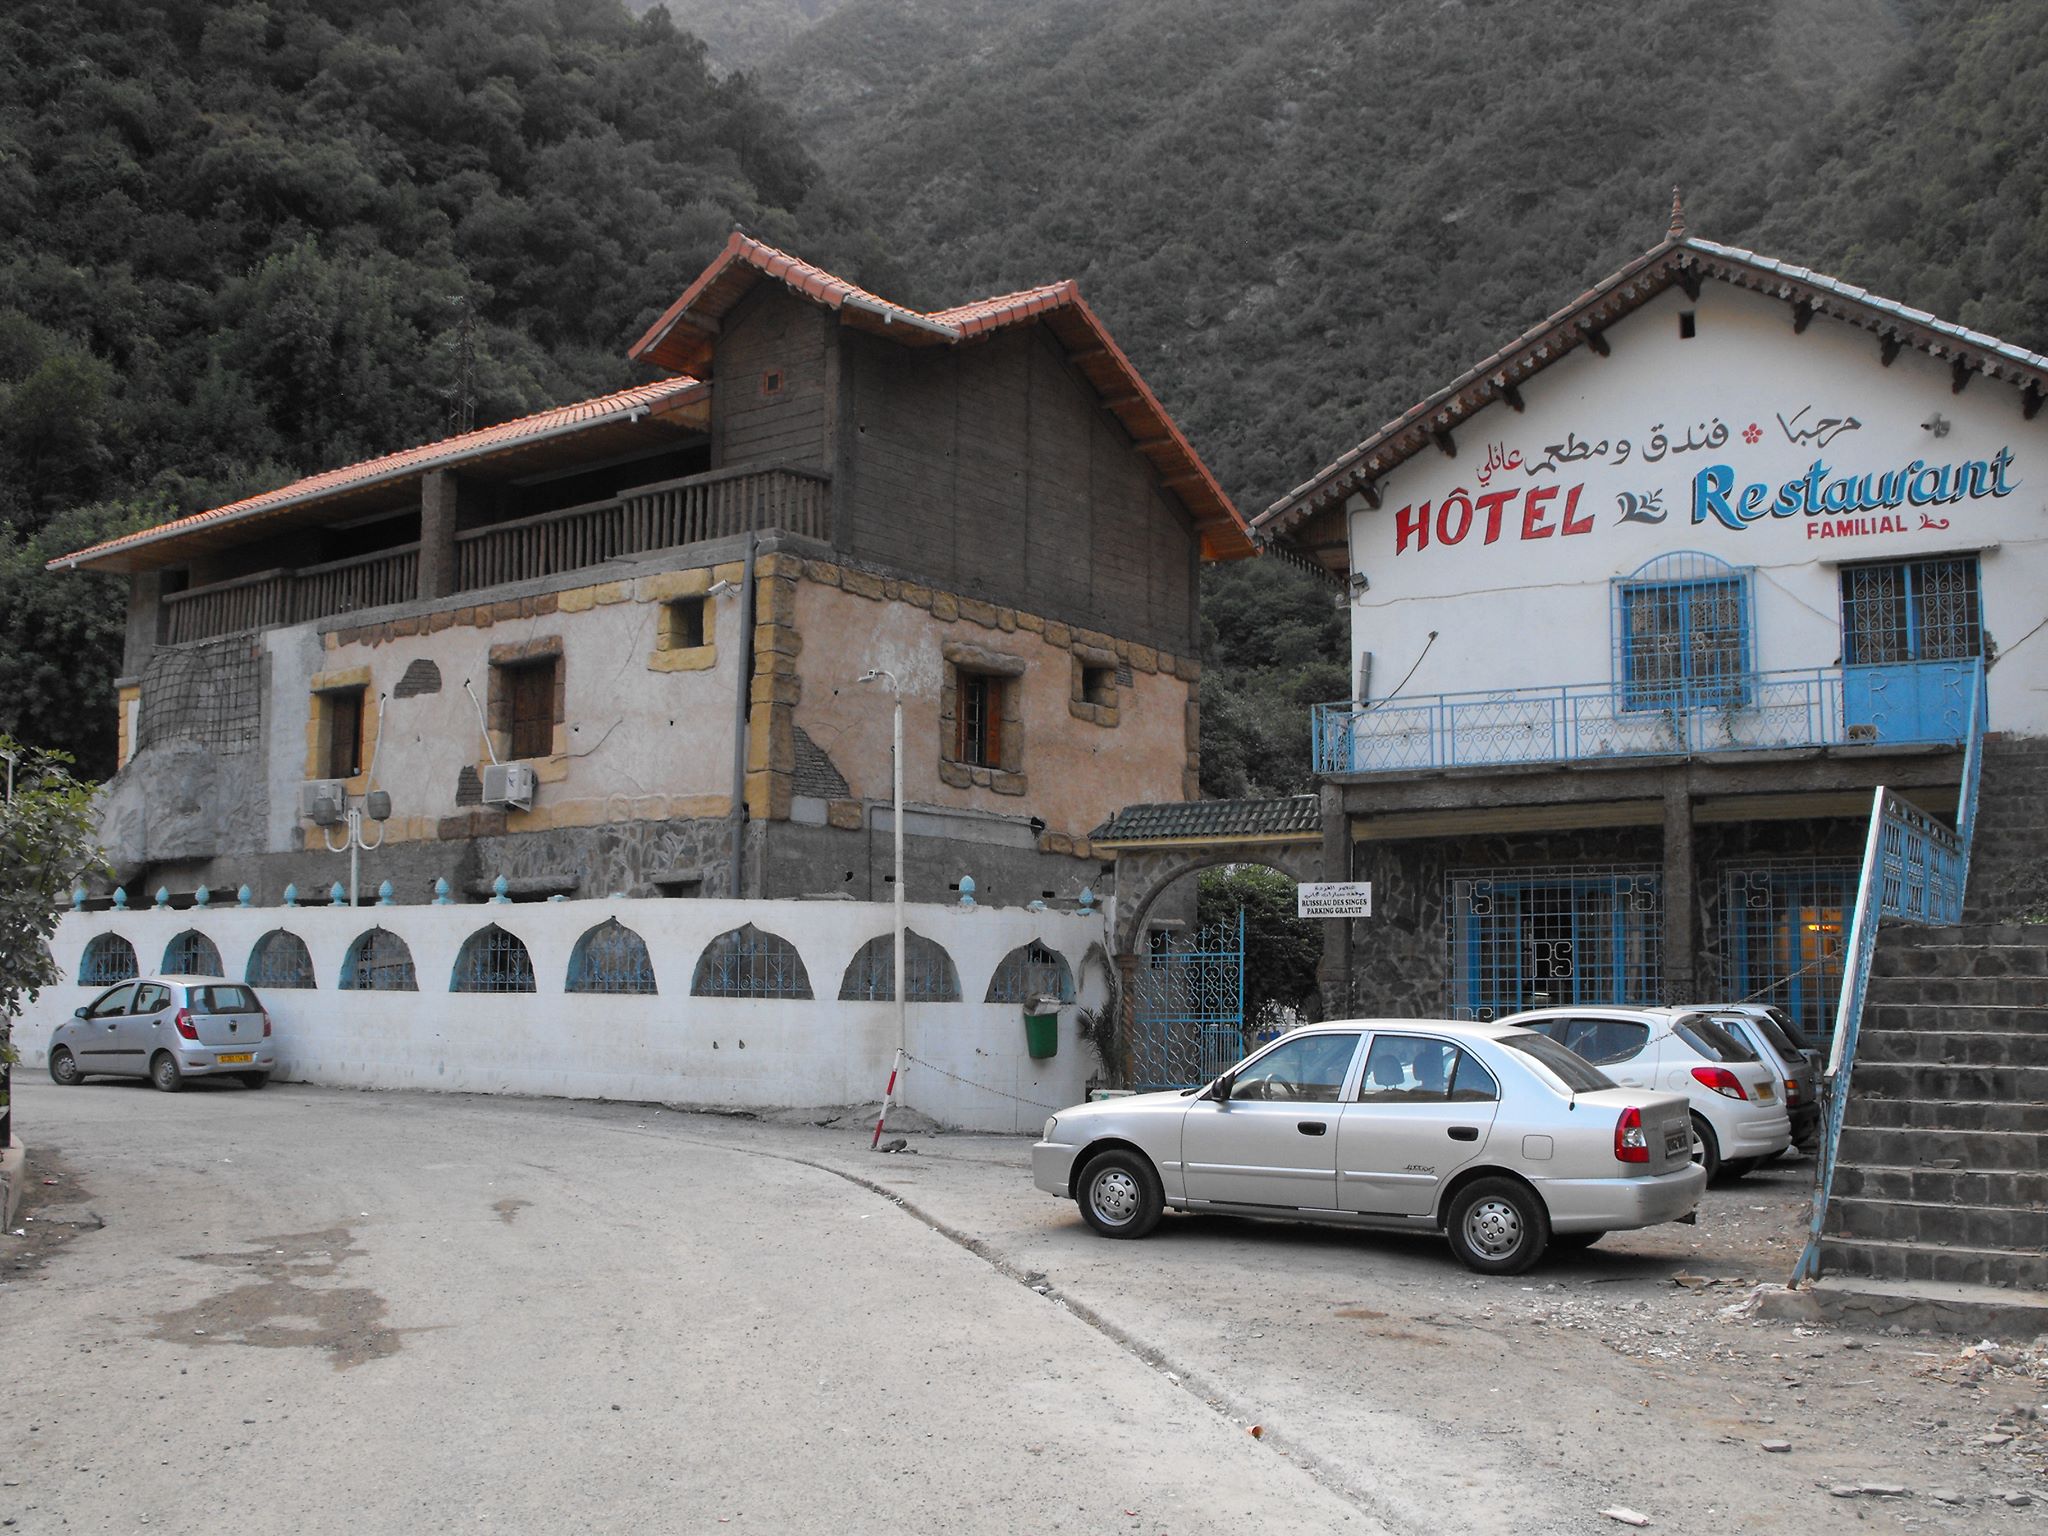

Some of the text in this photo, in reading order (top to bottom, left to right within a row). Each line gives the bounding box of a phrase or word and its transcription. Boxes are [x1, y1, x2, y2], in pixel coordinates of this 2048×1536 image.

[1642, 417, 1729, 462] فندق
[1477, 441, 1524, 487] عائلي
[1396, 446, 2023, 556] HÔTEL Restaurant
[1807, 515, 1908, 540] FAMILIAL
[1301, 899, 1332, 907] RUISSEAU
[1345, 898, 1367, 906] SINGES
[1307, 906, 1362, 915] PARKING GRATUIT
